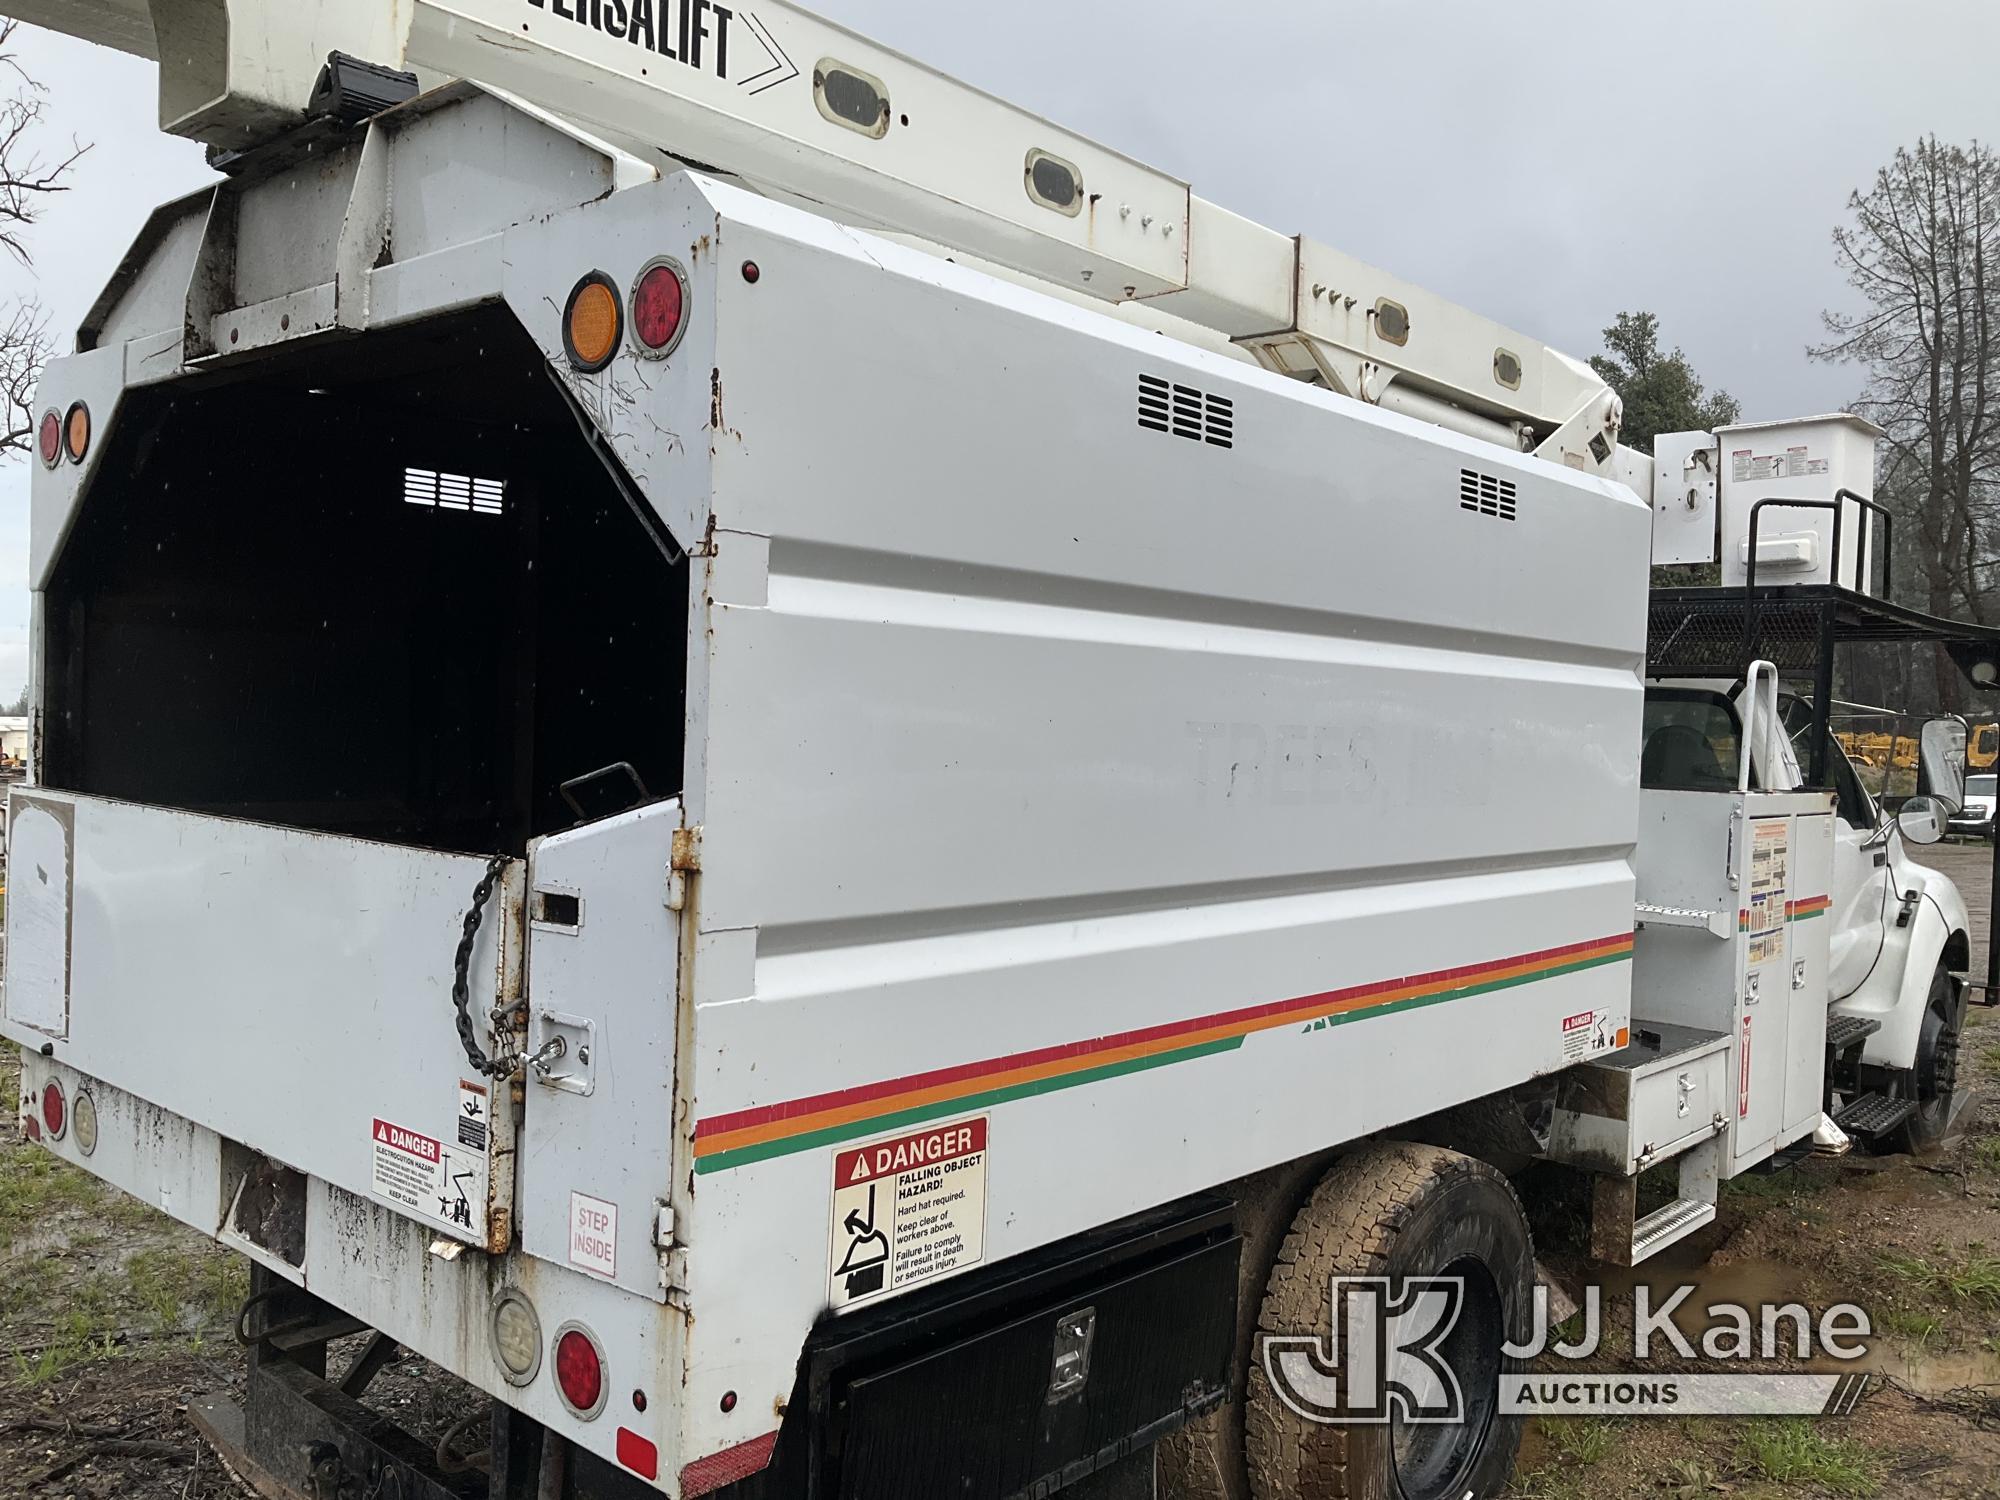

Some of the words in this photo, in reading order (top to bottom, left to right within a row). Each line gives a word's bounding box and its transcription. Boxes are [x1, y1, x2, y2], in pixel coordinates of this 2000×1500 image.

[527, 0, 733, 79] SALIFT
[390, 1128, 435, 1158] DANGER
[876, 1127, 972, 1174] DANGER
[376, 1145, 414, 1166] ELECTROCUTION
[414, 1161, 435, 1174] HAZARD
[899, 1166, 941, 1187] FALLING
[944, 1154, 982, 1173] OBJECT
[389, 1189, 402, 1200] KEEP
[402, 1194, 418, 1207] CLEAR
[897, 1202, 917, 1217] Hard
[918, 1199, 931, 1211] hat
[932, 1188, 966, 1206] required.
[898, 1178, 943, 1201] HAZARD!
[578, 1207, 609, 1233] STEP
[896, 1227, 928, 1245] workers
[930, 1220, 955, 1235] above.
[897, 1220, 918, 1234] Keep
[919, 1213, 938, 1227] clear
[939, 1209, 948, 1220] of
[574, 1231, 612, 1263] INSIDE
[895, 1246, 923, 1262] Failure
[924, 1243, 932, 1252] to
[933, 1233, 961, 1248] comply
[895, 1257, 909, 1273] will
[910, 1253, 933, 1268] result
[933, 1250, 941, 1260] in
[942, 1243, 964, 1257] death
[894, 1274, 904, 1284] or
[905, 1263, 934, 1280] serious
[935, 1256, 958, 1270] injury.
